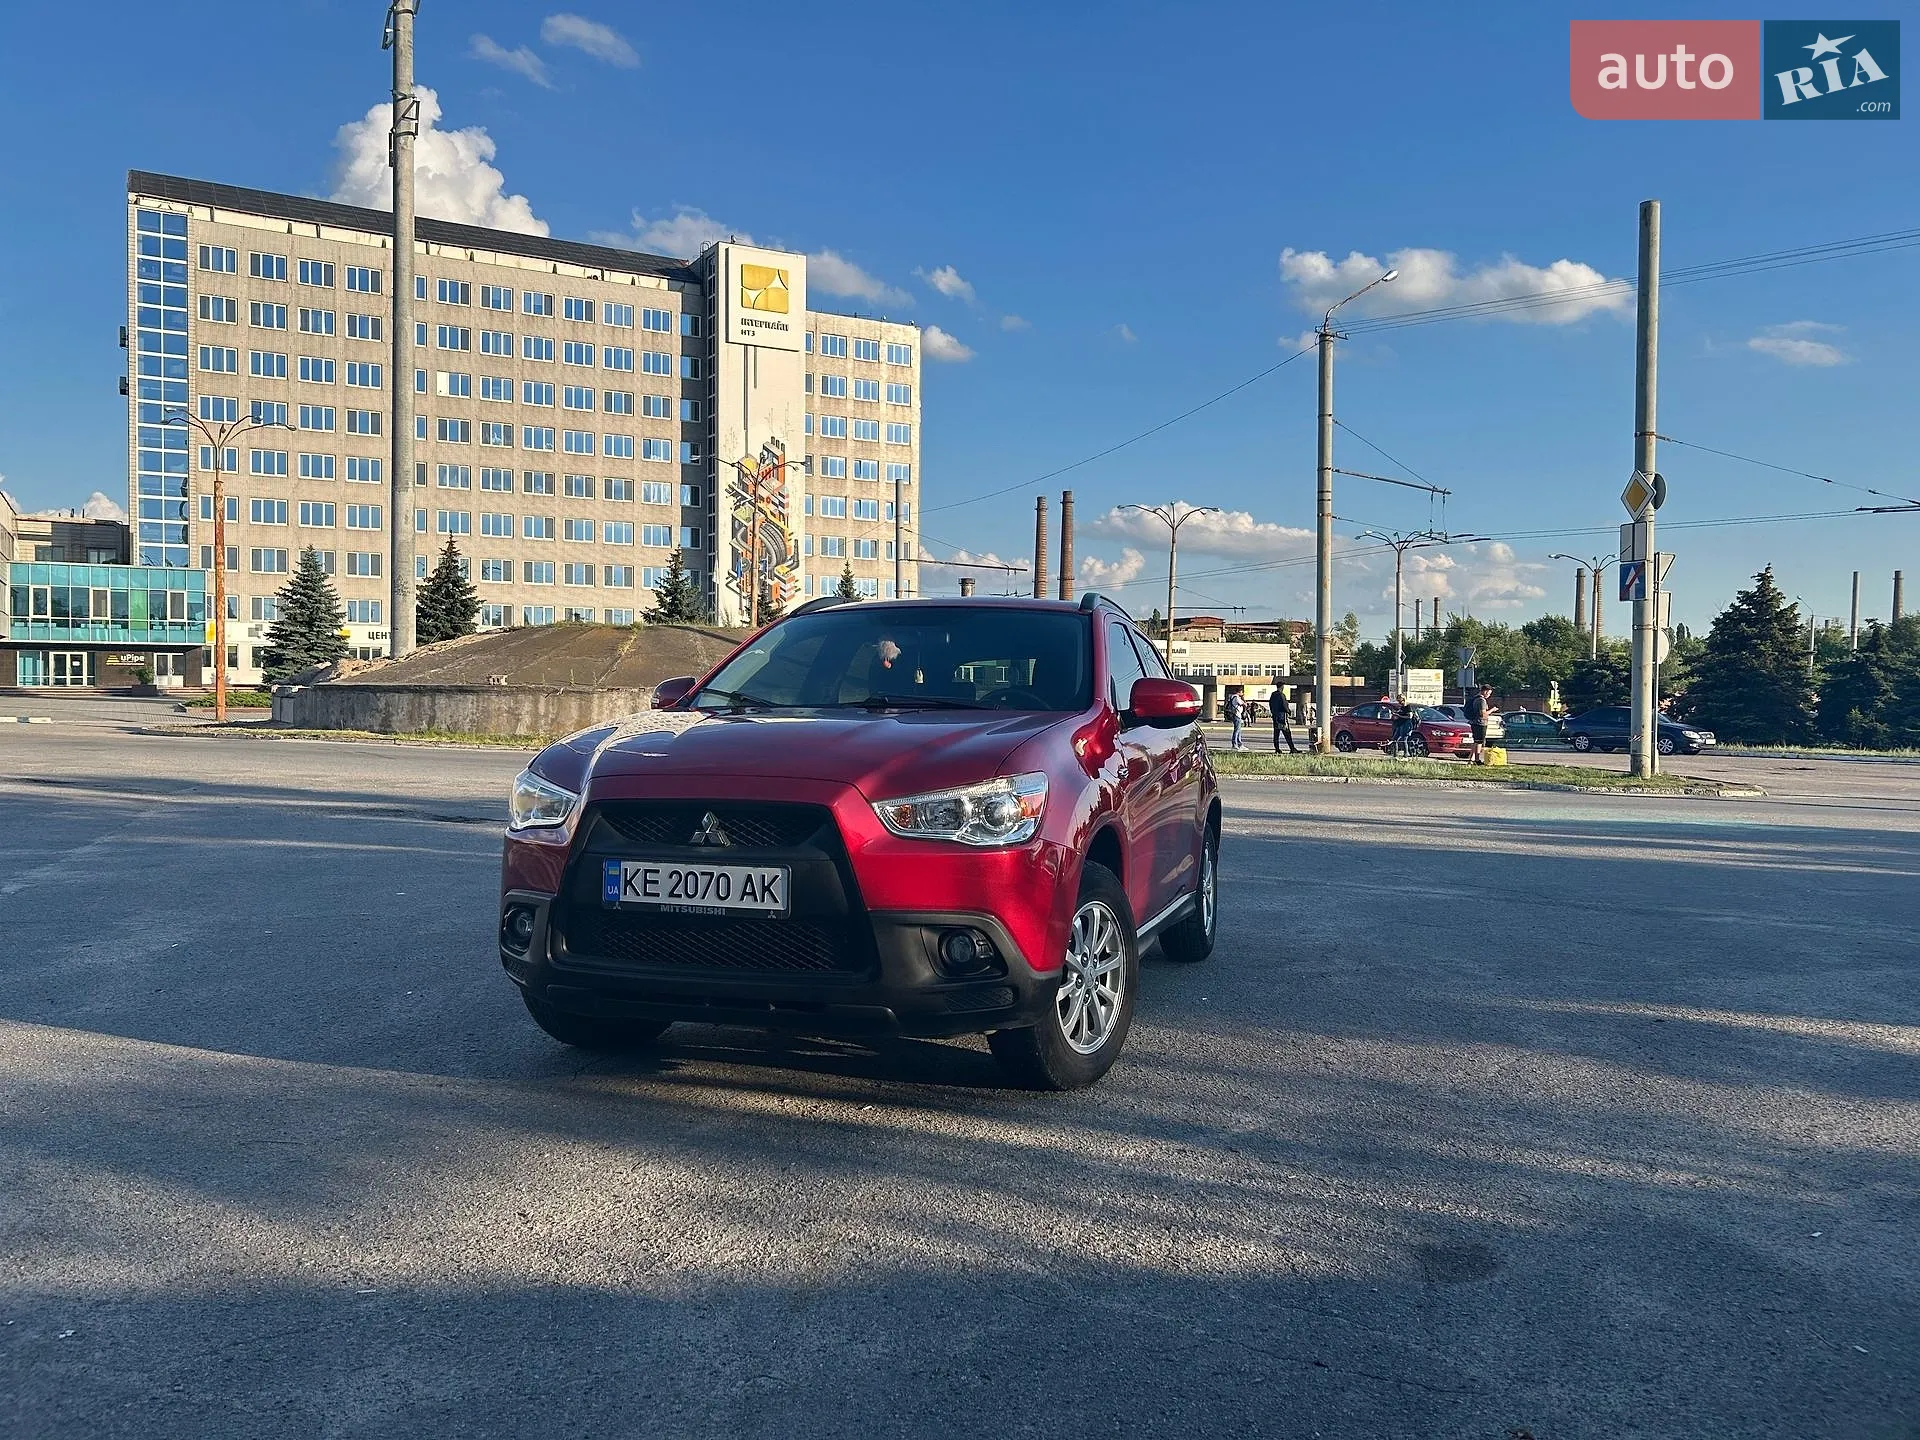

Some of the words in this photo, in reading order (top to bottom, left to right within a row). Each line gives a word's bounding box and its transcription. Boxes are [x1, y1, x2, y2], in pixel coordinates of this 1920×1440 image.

[120, 653, 145, 663] uPipe
[607, 885, 619, 895] UA
[623, 867, 661, 898] KE
[668, 870, 731, 901] 2070
[740, 873, 782, 904] AK
[660, 904, 726, 916] MITSUBISHI
